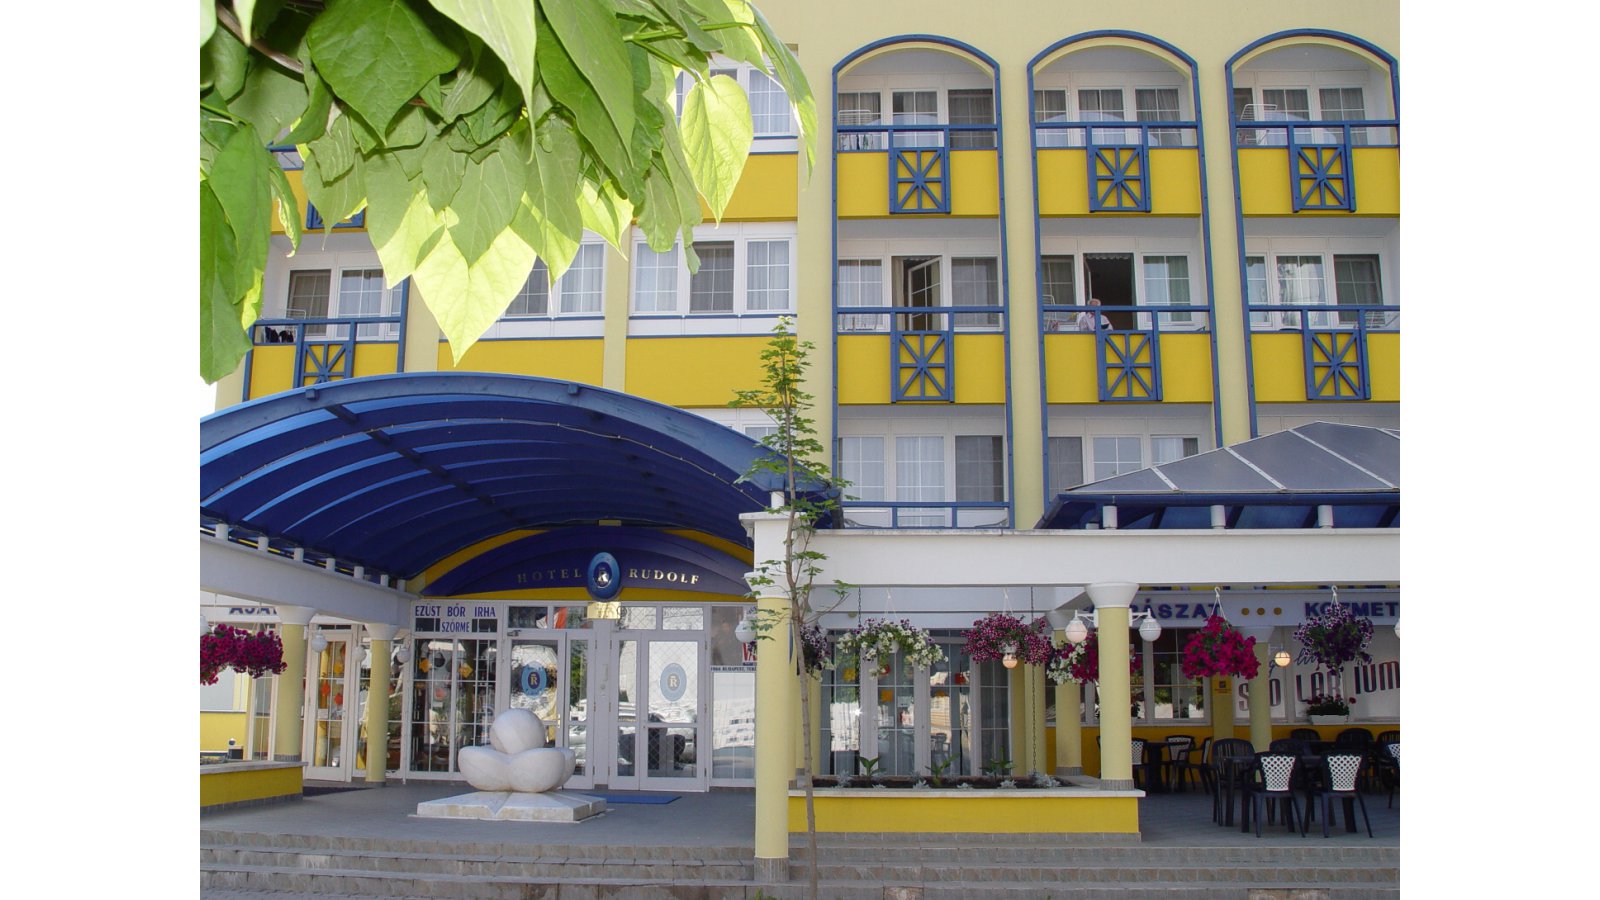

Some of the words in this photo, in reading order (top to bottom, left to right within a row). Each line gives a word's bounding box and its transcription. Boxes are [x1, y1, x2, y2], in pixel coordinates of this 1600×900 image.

[517, 568, 582, 583] HOTEL
[629, 568, 700, 585] RUDOLF
[474, 606, 496, 617] IRHA
